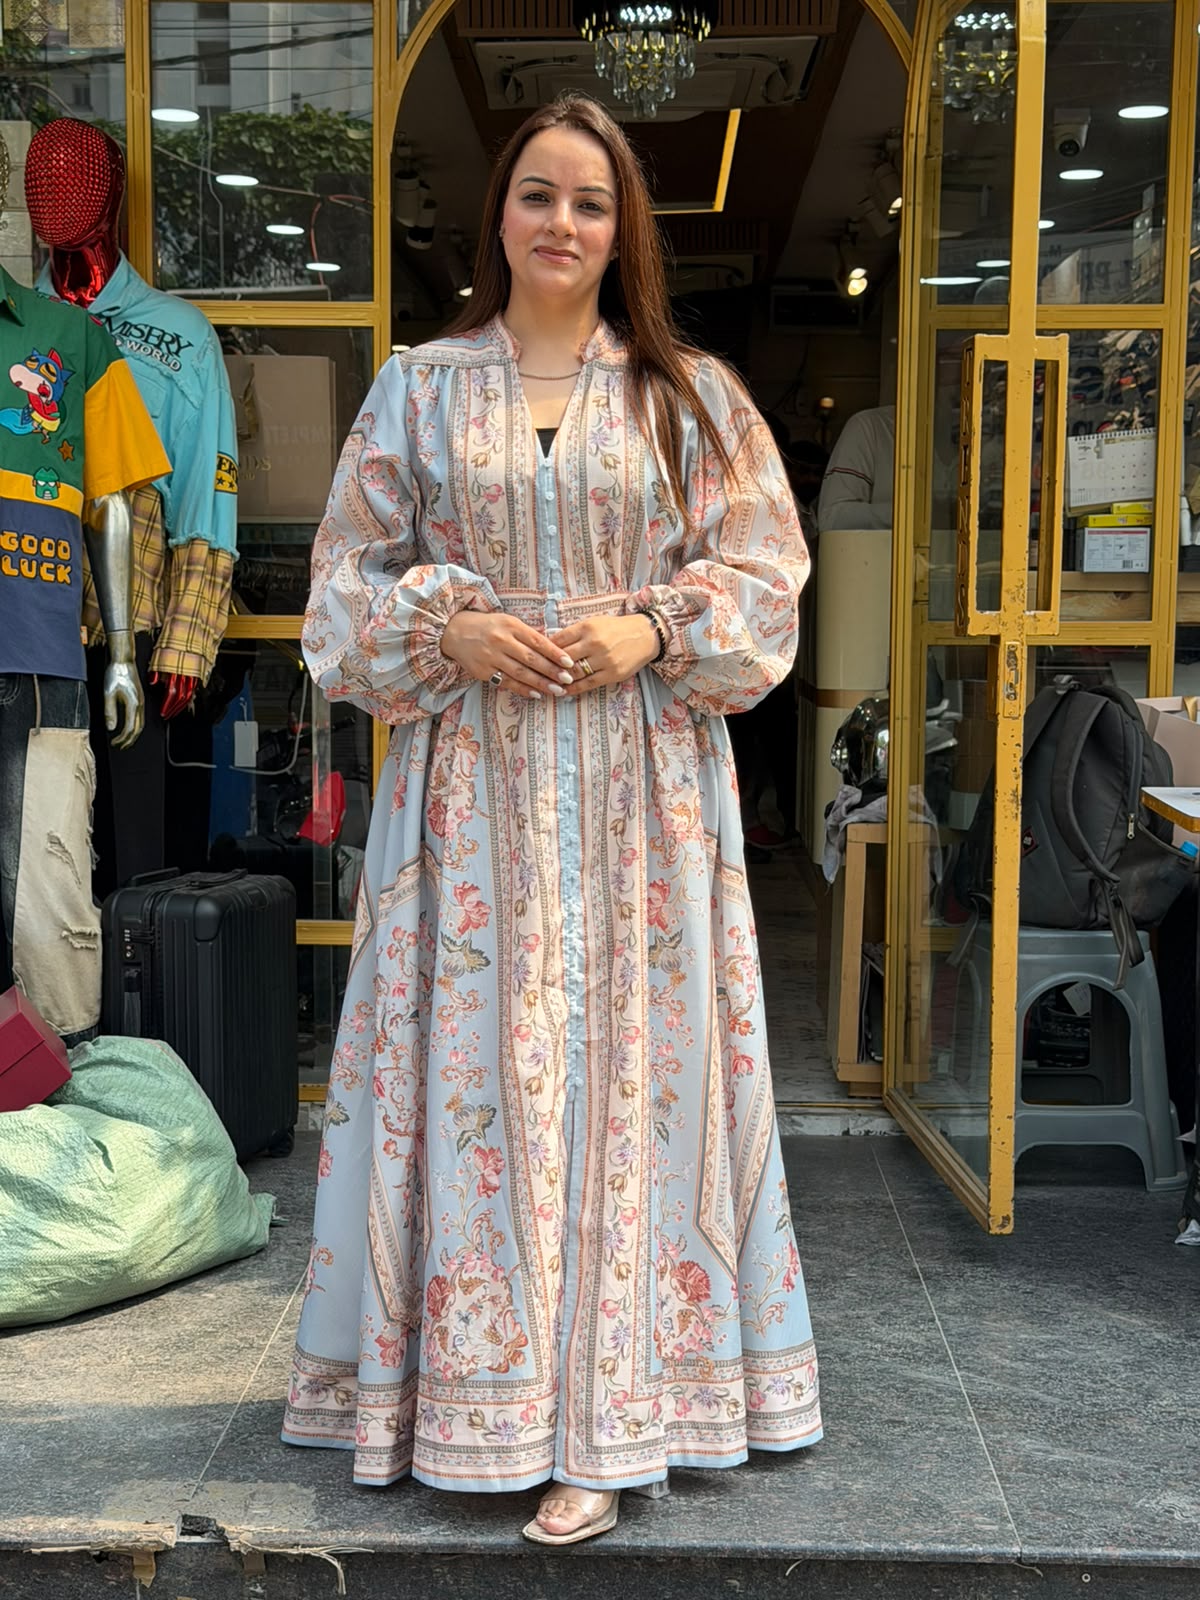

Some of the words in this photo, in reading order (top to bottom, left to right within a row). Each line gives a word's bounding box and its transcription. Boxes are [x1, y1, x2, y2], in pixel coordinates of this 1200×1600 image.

[104, 316, 194, 358] MISERY
[126, 340, 182, 373] WORLD
[0, 529, 71, 562] GOOD
[1, 555, 72, 587] LUCK
